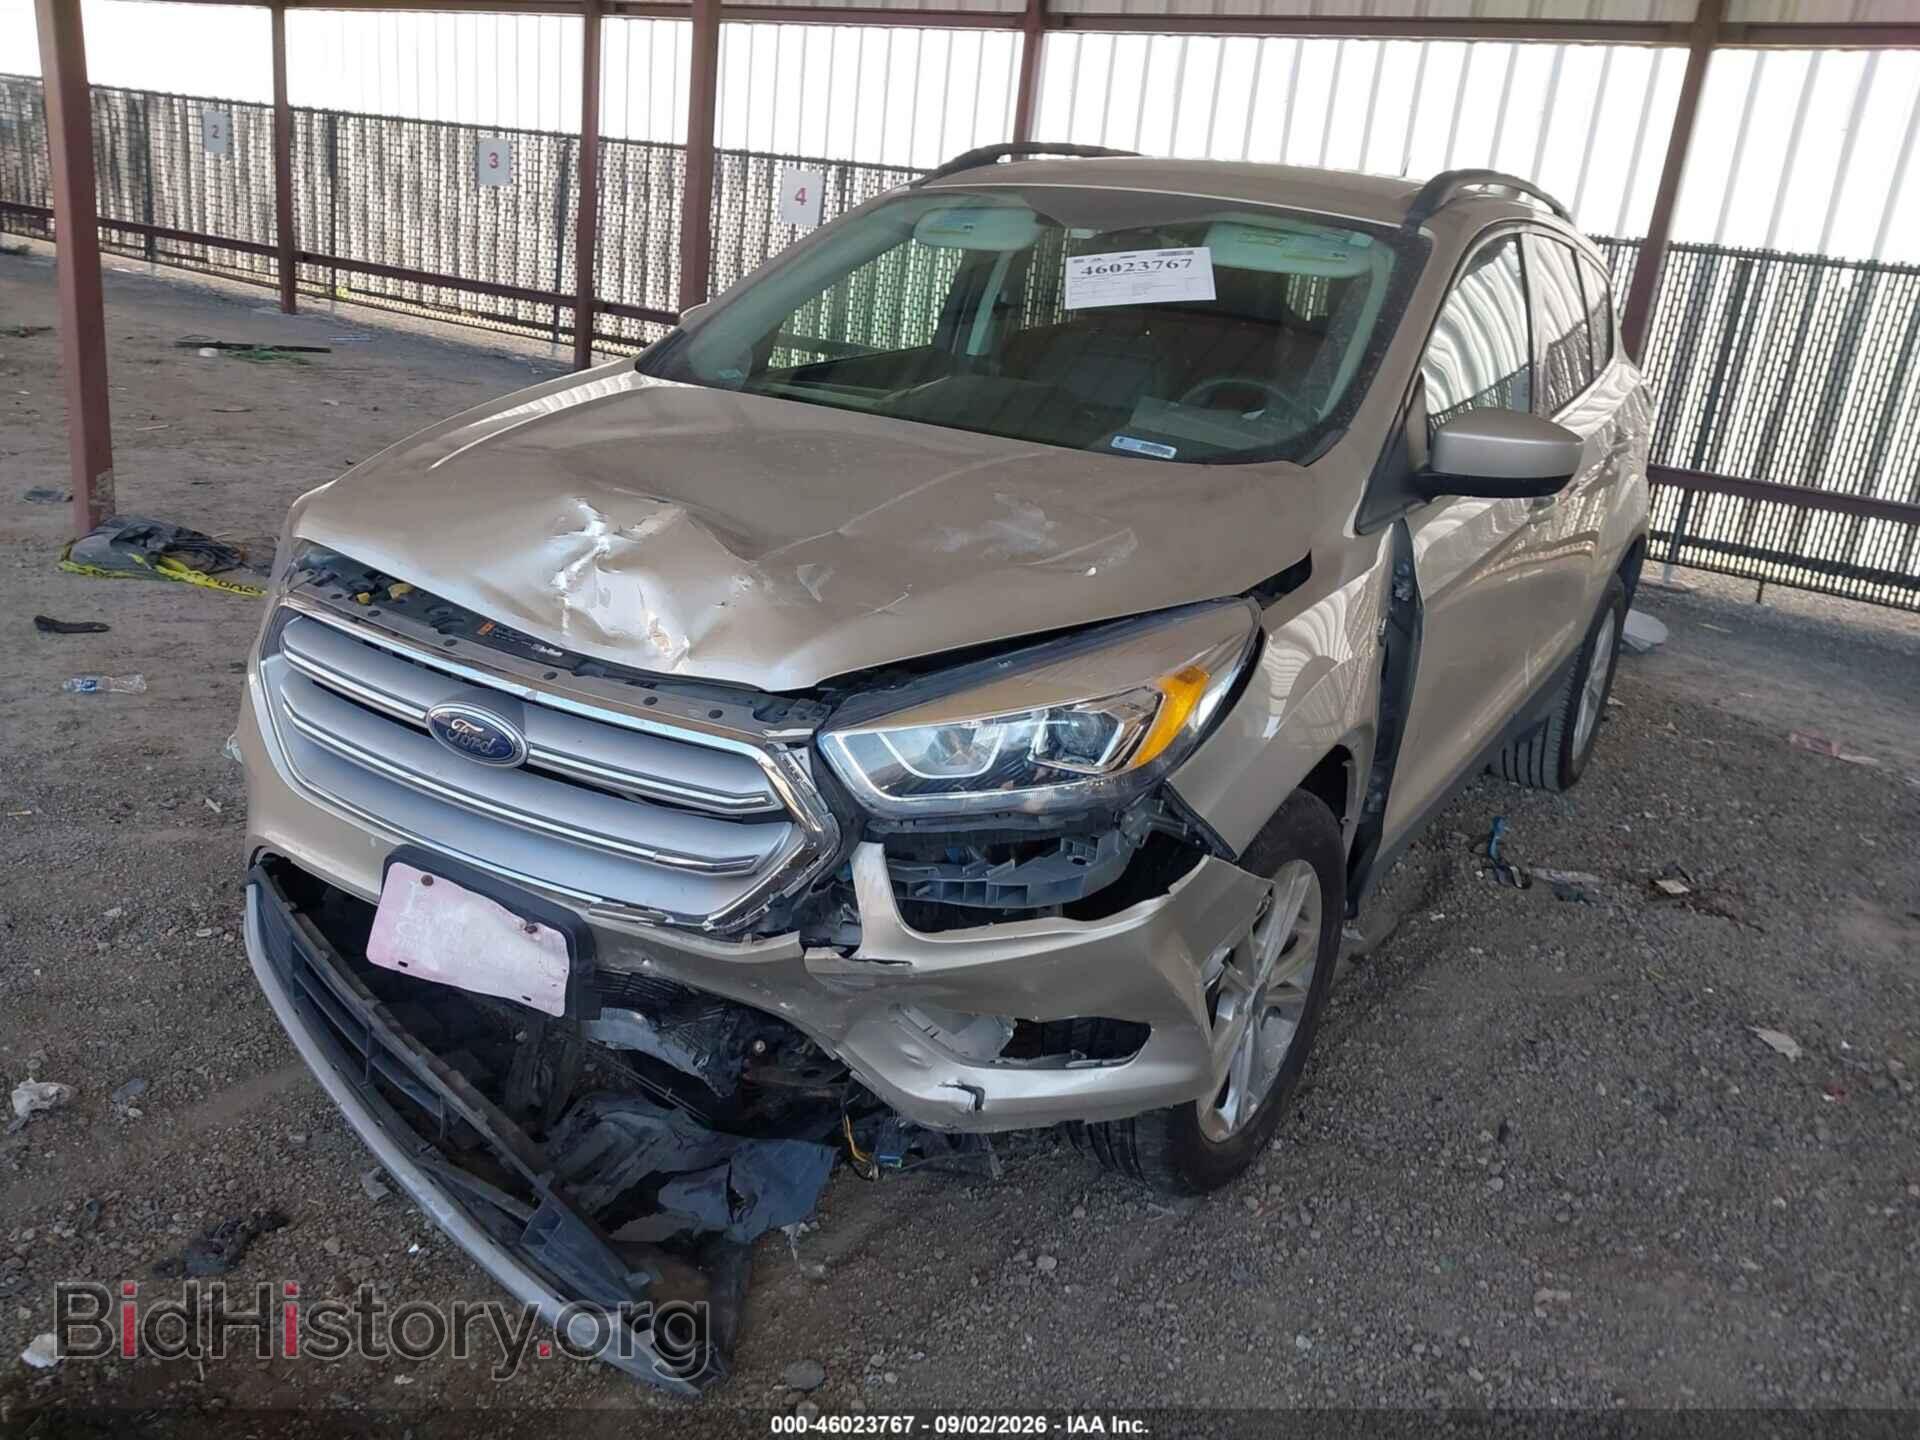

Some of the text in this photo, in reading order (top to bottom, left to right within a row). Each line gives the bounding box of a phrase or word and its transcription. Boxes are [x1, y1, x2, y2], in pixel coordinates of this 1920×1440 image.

[211, 124, 220, 139] 2
[489, 152, 499, 169] 3
[794, 187, 807, 206] 4
[1080, 258, 1193, 275] 46023767
[446, 718, 497, 754] Ford
